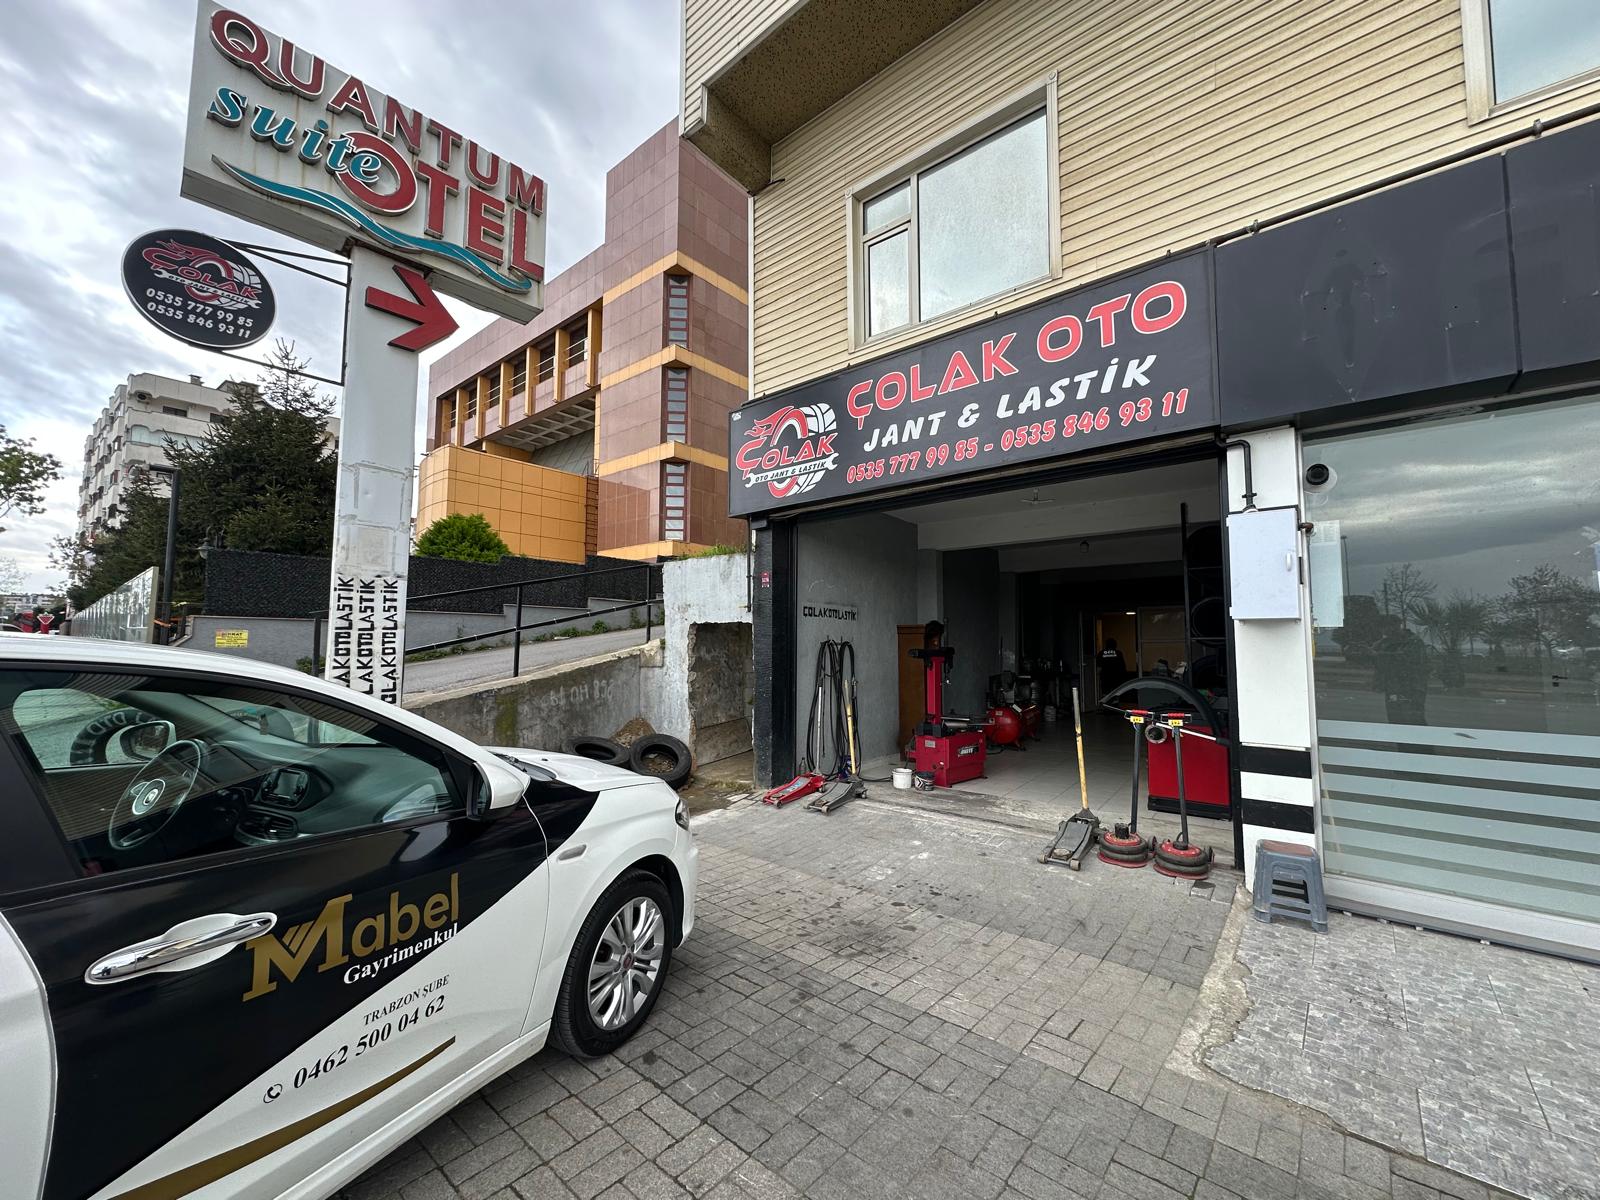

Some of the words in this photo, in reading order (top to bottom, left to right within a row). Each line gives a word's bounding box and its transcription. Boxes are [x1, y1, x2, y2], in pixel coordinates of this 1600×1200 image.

[210, 9, 544, 216] QUANTUM
[332, 131, 545, 282] OTEL
[146, 288, 183, 307] 0535
[187, 301, 213, 315] 777
[216, 310, 234, 322] 99
[237, 316, 254, 327] 85
[147, 302, 183, 320] 0535
[187, 314, 213, 329] 846
[218, 323, 235, 335] 93
[238, 329, 251, 338] 11
[847, 332, 1019, 430] ÇOLAK
[1036, 280, 1187, 363] OTO
[847, 458, 885, 484] 0535
[889, 450, 921, 475] 777
[925, 443, 950, 468] 99
[954, 437, 979, 461] 85
[1001, 419, 1056, 451] 0535
[1062, 407, 1110, 437] 846
[1119, 397, 1152, 427] 93
[1162, 388, 1189, 416] 11
[863, 411, 947, 452] JANT
[957, 402, 980, 428] &
[996, 354, 1157, 419] LASTİK
[736, 432, 838, 480] ÇOLAK
[755, 473, 768, 482] OTO
[770, 468, 790, 479] JANT
[799, 460, 827, 473] LASTİK
[332, 577, 354, 688] AKOTOLASTİK
[243, 872, 459, 1002] Mabel
[343, 923, 458, 984] Gayrimenkul
[293, 1045, 349, 1089] 0462
[355, 1022, 392, 1057] 500
[397, 1010, 419, 1034] 04
[425, 994, 445, 1018] 62
[363, 989, 420, 1026] TRABZON
[421, 974, 450, 998] ŞUBE
